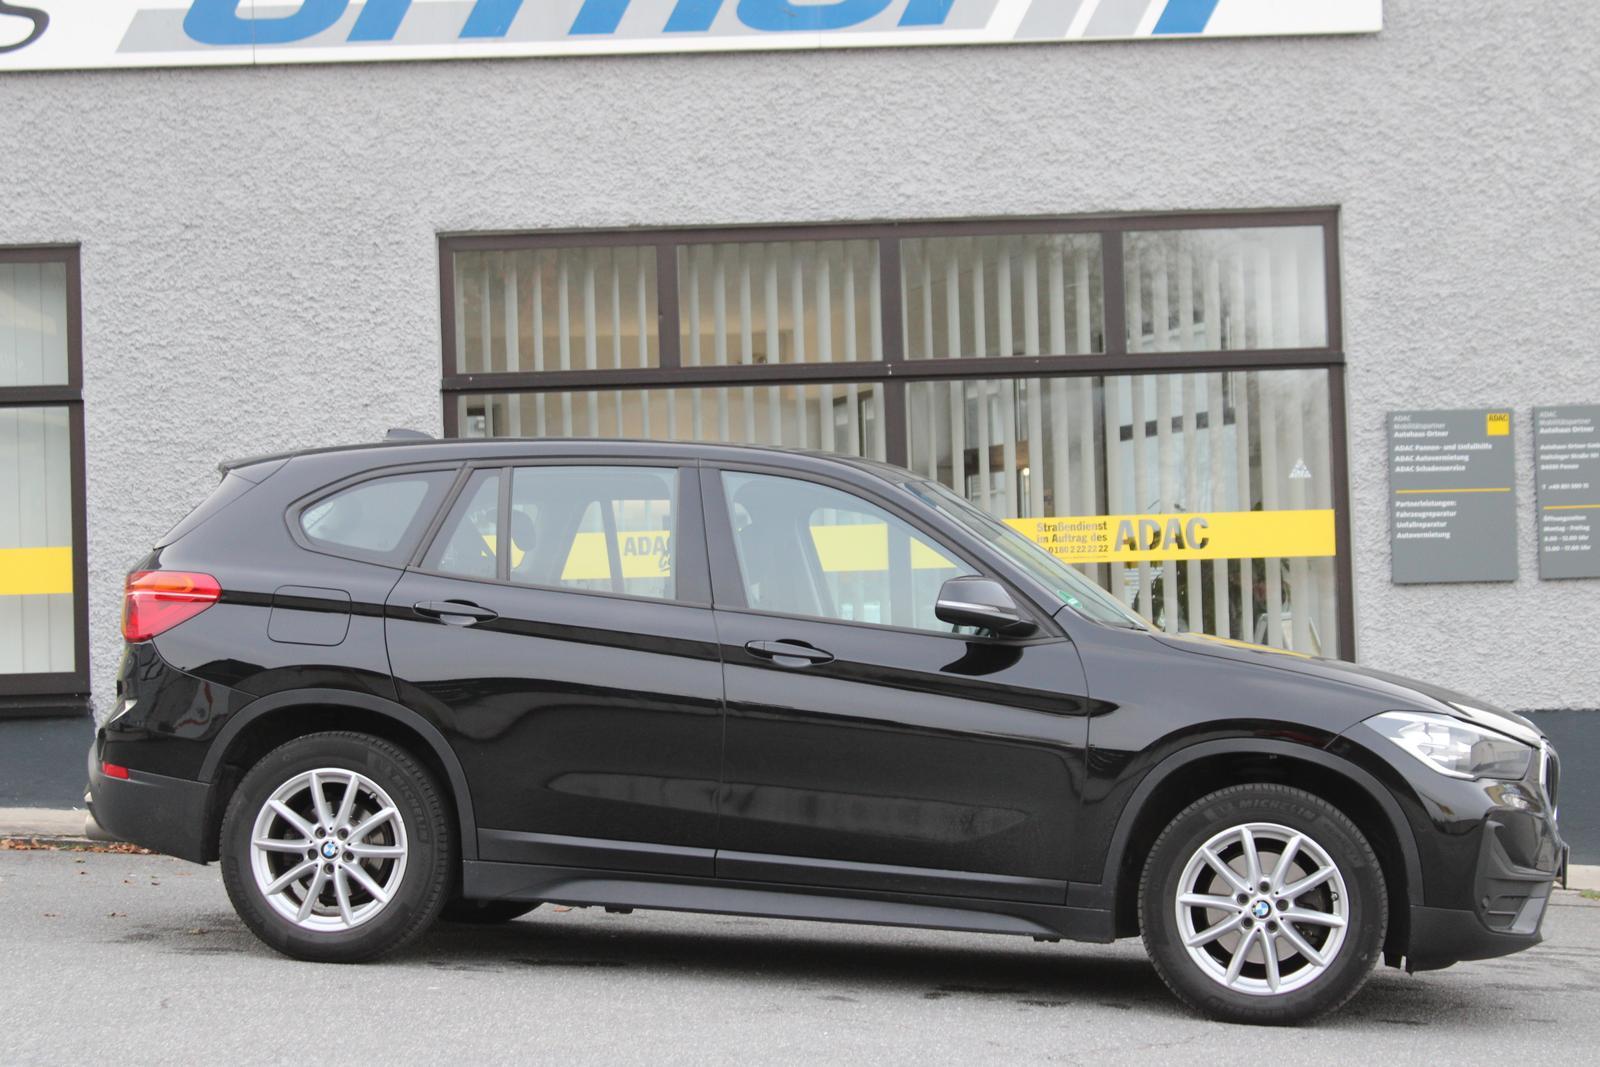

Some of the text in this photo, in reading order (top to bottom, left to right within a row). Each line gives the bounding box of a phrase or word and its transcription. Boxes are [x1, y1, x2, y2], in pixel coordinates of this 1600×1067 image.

[1415, 454, 1470, 462] Autovermietung
[1396, 500, 1456, 508] Partnerleistungen:
[1396, 510, 1456, 518] Fahrzeugreparatur
[1036, 522, 1108, 532] Straßendienst
[1396, 521, 1448, 529] Unfallreparatur
[1037, 532, 1108, 544] im Auftrag des
[1114, 517, 1209, 552] ADAC
[1396, 531, 1450, 539] Autovermietung
[624, 536, 671, 557] ADA
[1239, 798, 1316, 820] MICHELIN
